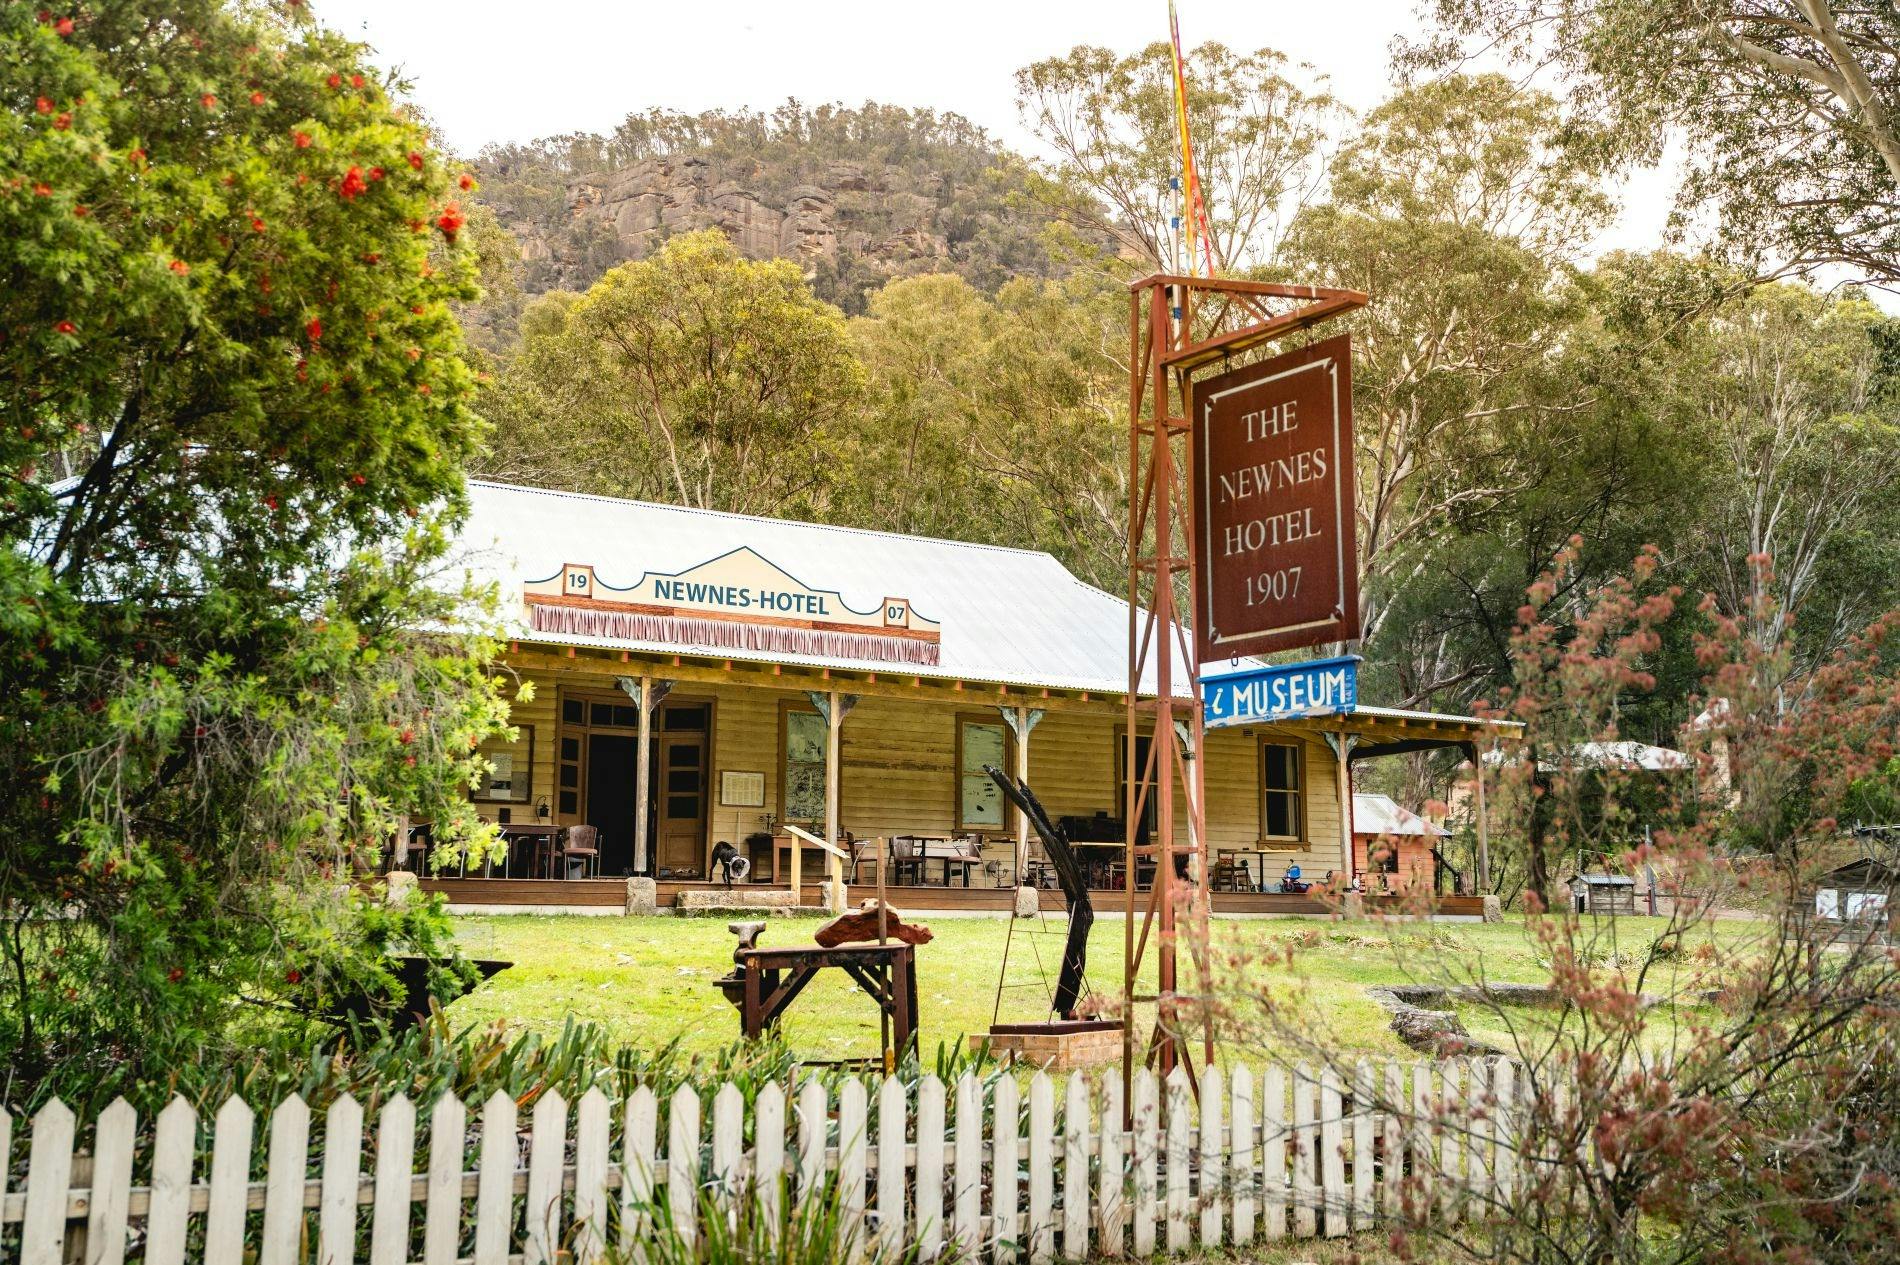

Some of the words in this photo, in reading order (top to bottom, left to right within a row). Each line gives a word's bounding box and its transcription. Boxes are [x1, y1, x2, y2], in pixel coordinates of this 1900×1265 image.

[1241, 400, 1298, 442] THE
[1220, 447, 1327, 503] NEWNES
[1223, 507, 1321, 556] HOTEL
[569, 573, 587, 588] 19
[654, 579, 830, 615] NEWNES-HOTEL
[888, 606, 905, 620] 07
[1245, 566, 1302, 606] 1907
[1232, 668, 1346, 716] MUSEUM
